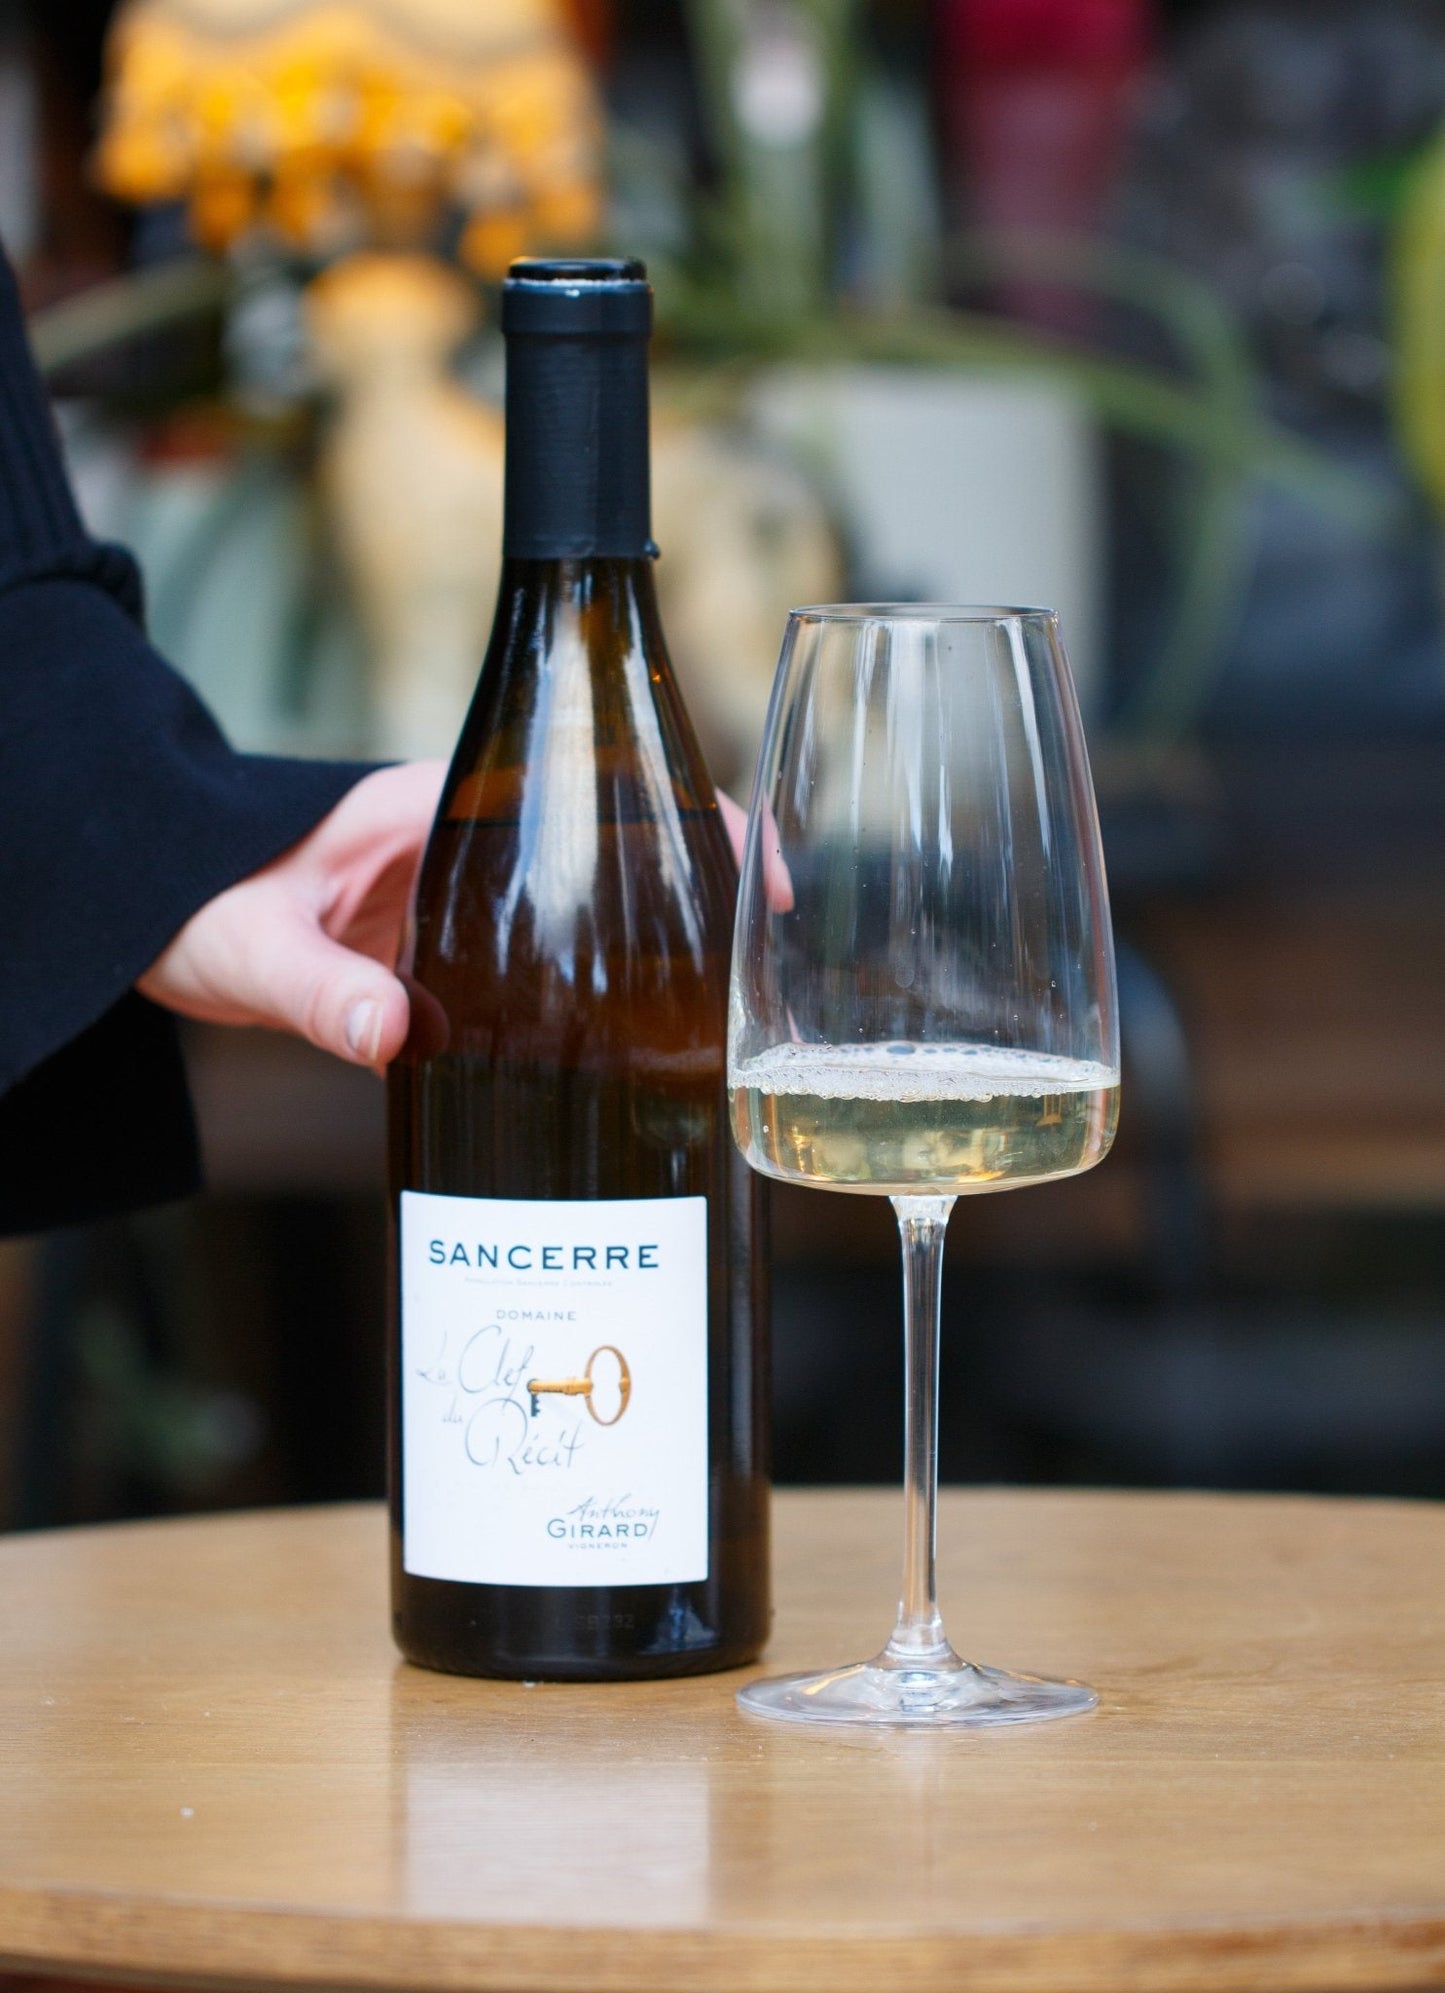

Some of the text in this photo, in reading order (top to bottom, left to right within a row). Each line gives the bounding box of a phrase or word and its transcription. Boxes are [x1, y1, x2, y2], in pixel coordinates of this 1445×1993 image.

[428, 1239, 660, 1270] SANCERRE
[495, 1309, 577, 1321] DOMAINE
[458, 1325, 535, 1414] Clef
[546, 1518, 649, 1539] GIRARD
[566, 1492, 660, 1541] Anthony
